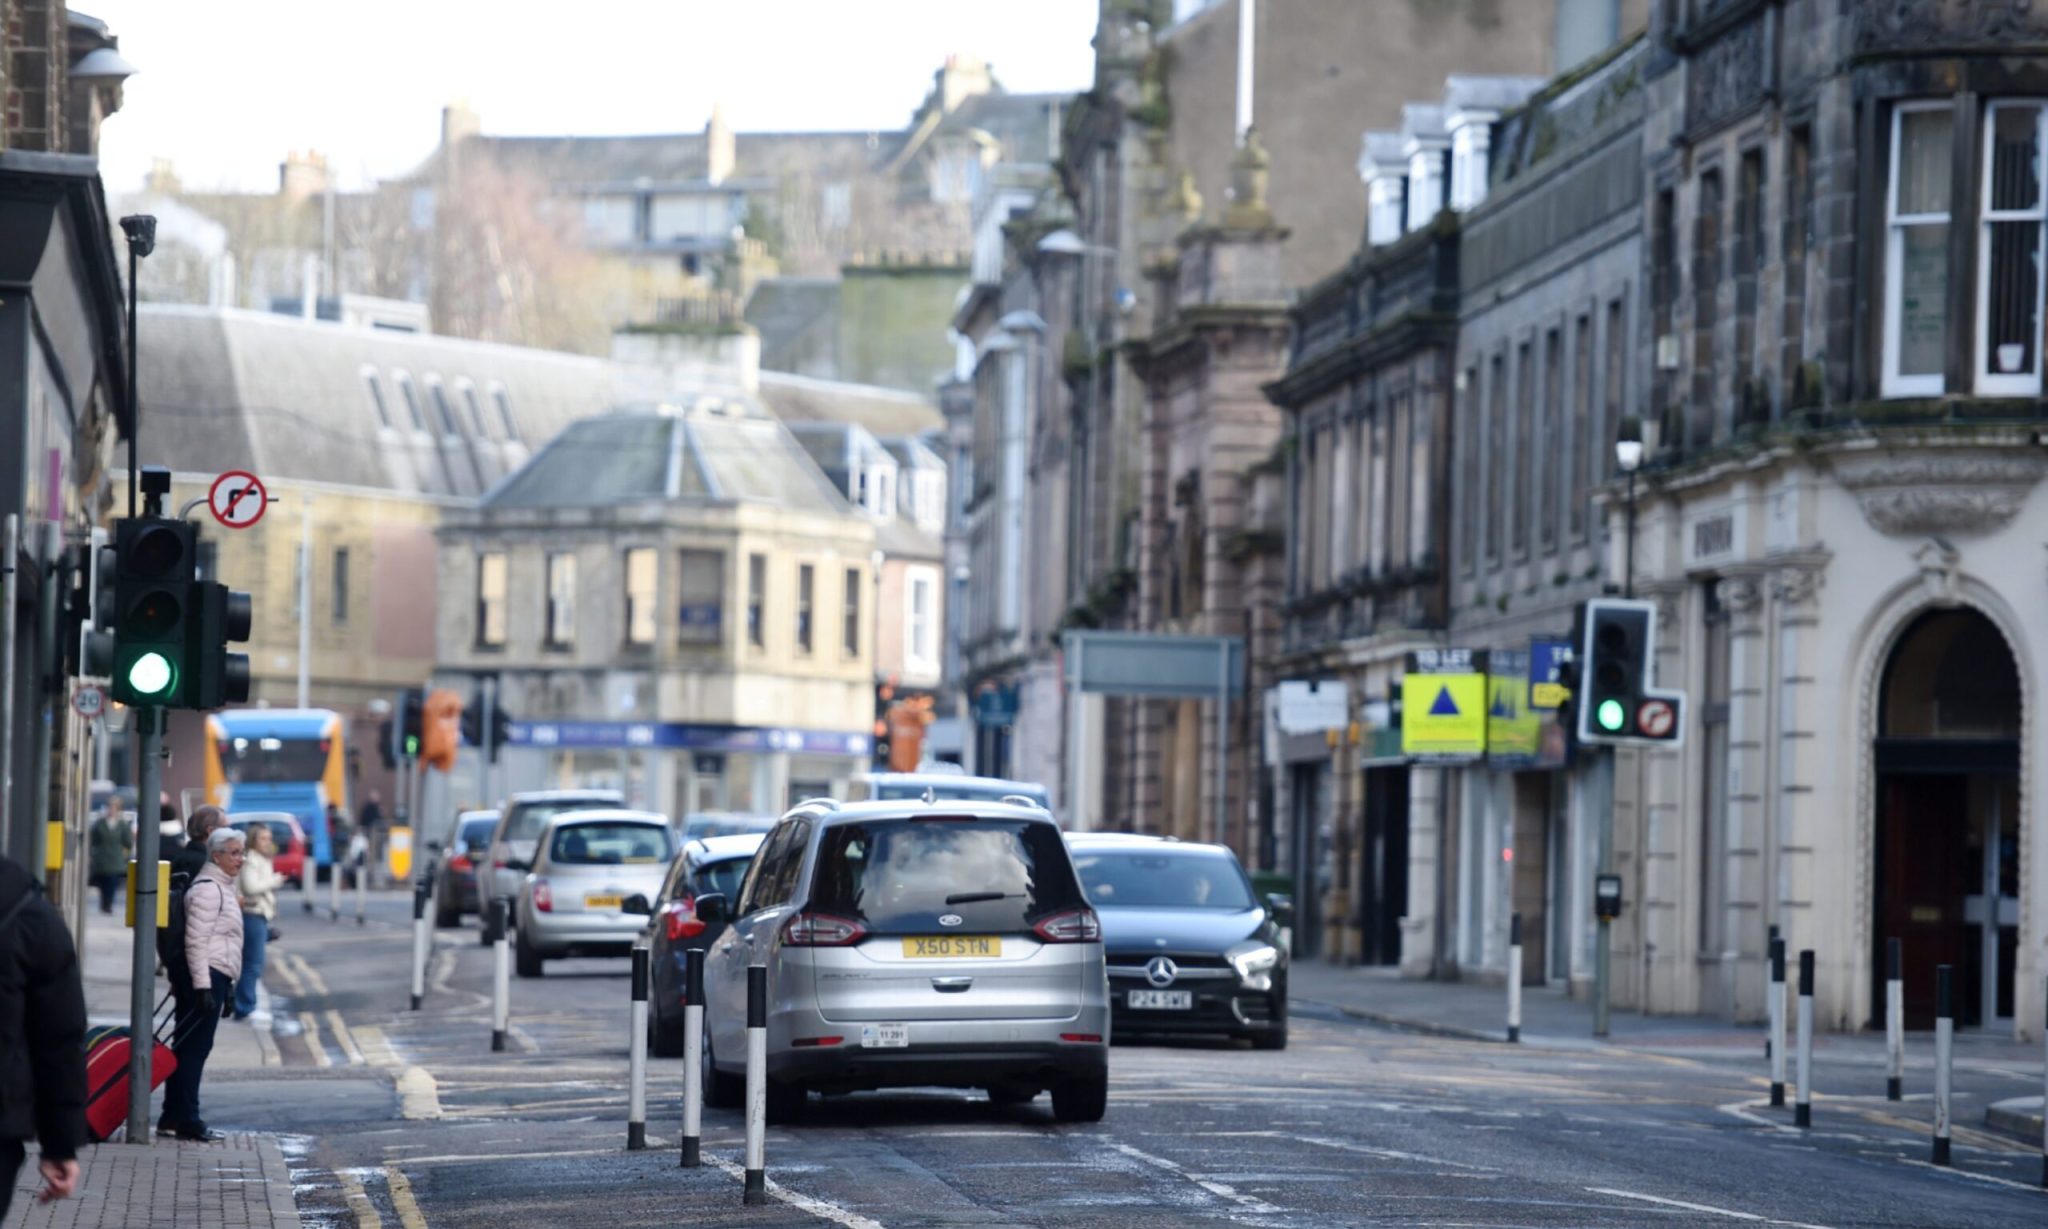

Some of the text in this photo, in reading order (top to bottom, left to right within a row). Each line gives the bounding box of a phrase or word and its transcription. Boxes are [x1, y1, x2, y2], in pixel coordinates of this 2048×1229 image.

[1442, 648, 1472, 666] LET
[79, 692, 99, 708] 20
[915, 937, 989, 954] X50 STN
